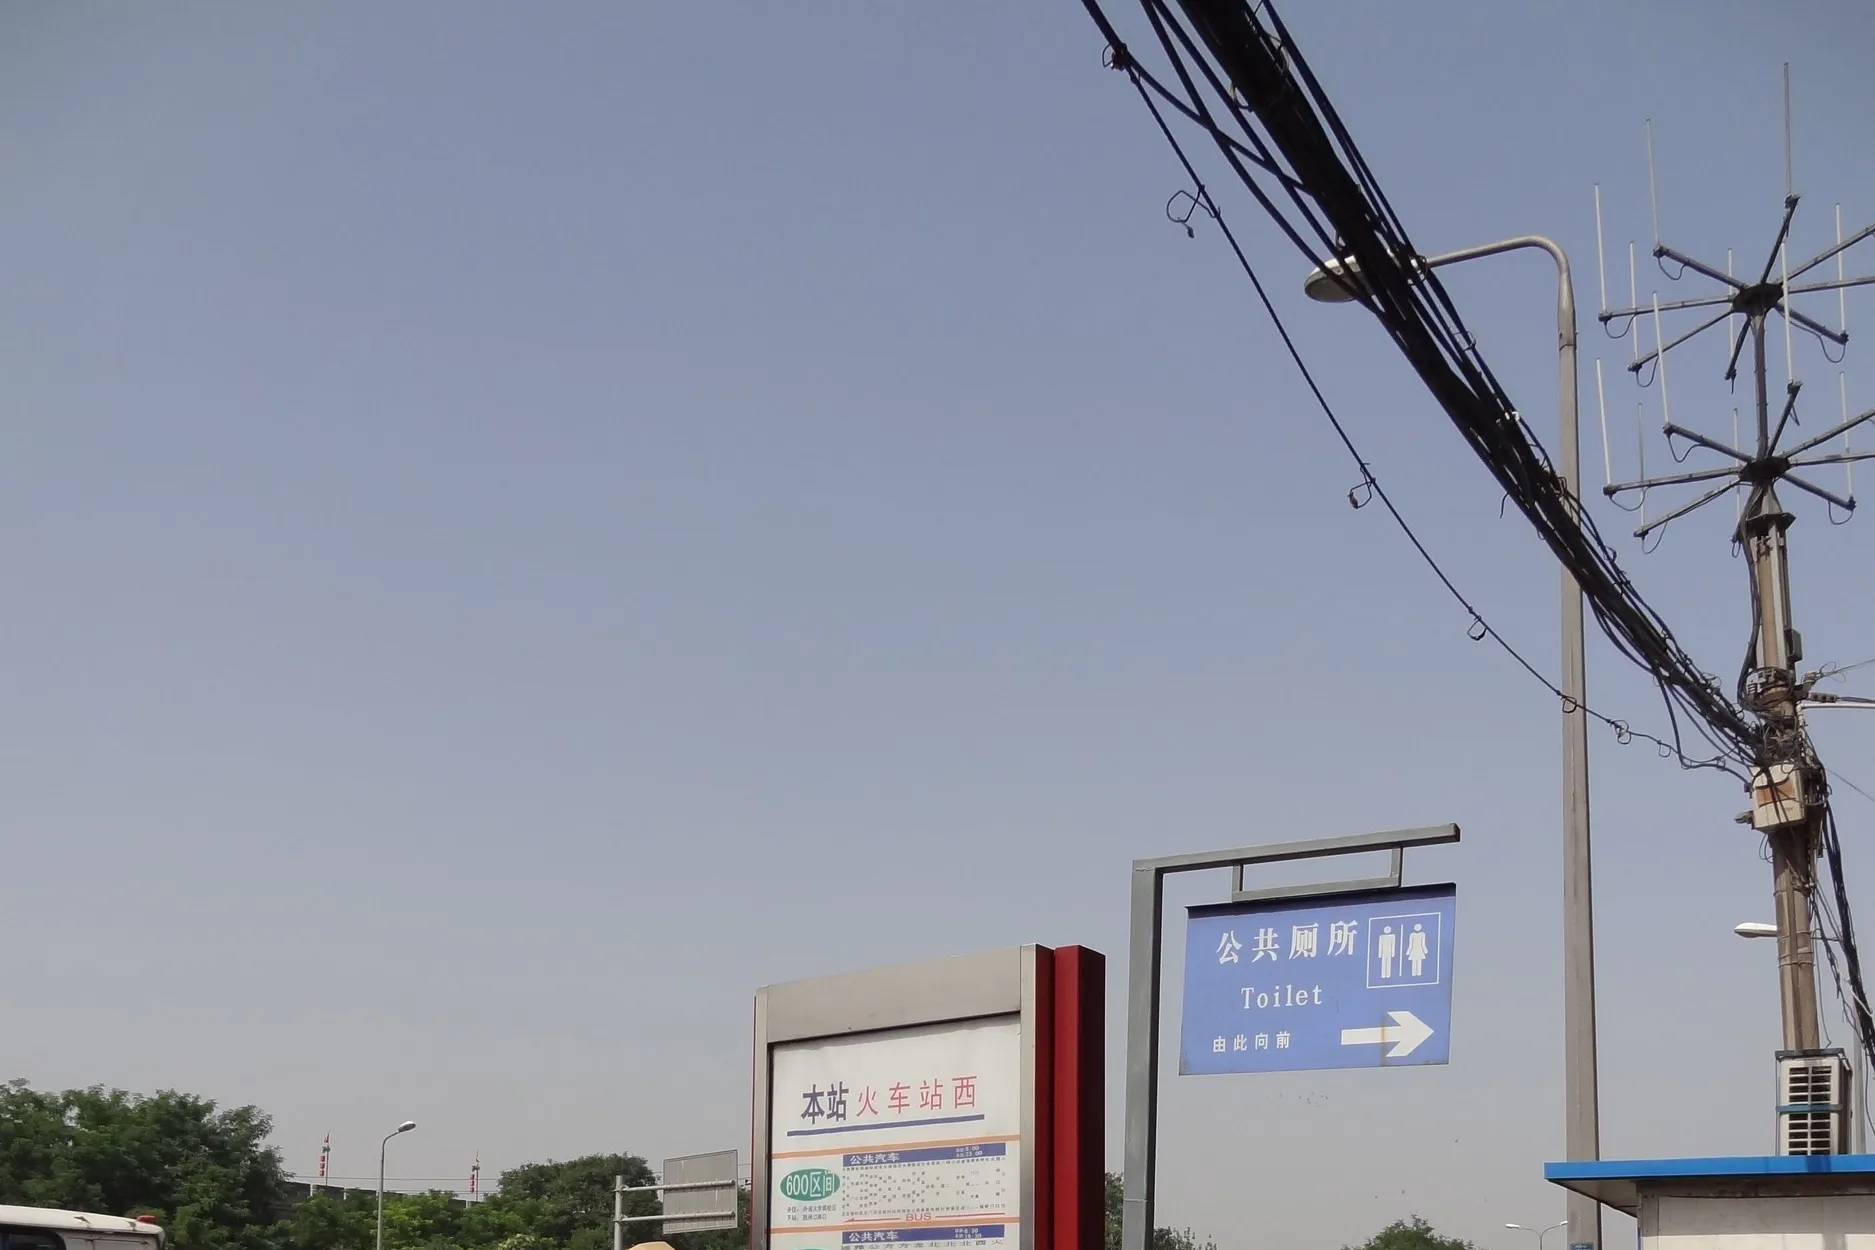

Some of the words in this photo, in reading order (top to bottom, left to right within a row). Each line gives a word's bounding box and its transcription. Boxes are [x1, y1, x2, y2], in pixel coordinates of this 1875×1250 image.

[1215, 920, 1358, 965] 公共厕所
[1241, 984, 1323, 1010] Toilet
[1212, 1030, 1291, 1053] 由此向前
[800, 1080, 850, 1125] 本站
[856, 1075, 978, 1117] 火车站西
[850, 1152, 900, 1166] 公共汽车
[785, 1171, 834, 1197] 600区间
[905, 1212, 932, 1222] BUS
[849, 1230, 899, 1243] 公共汽车
